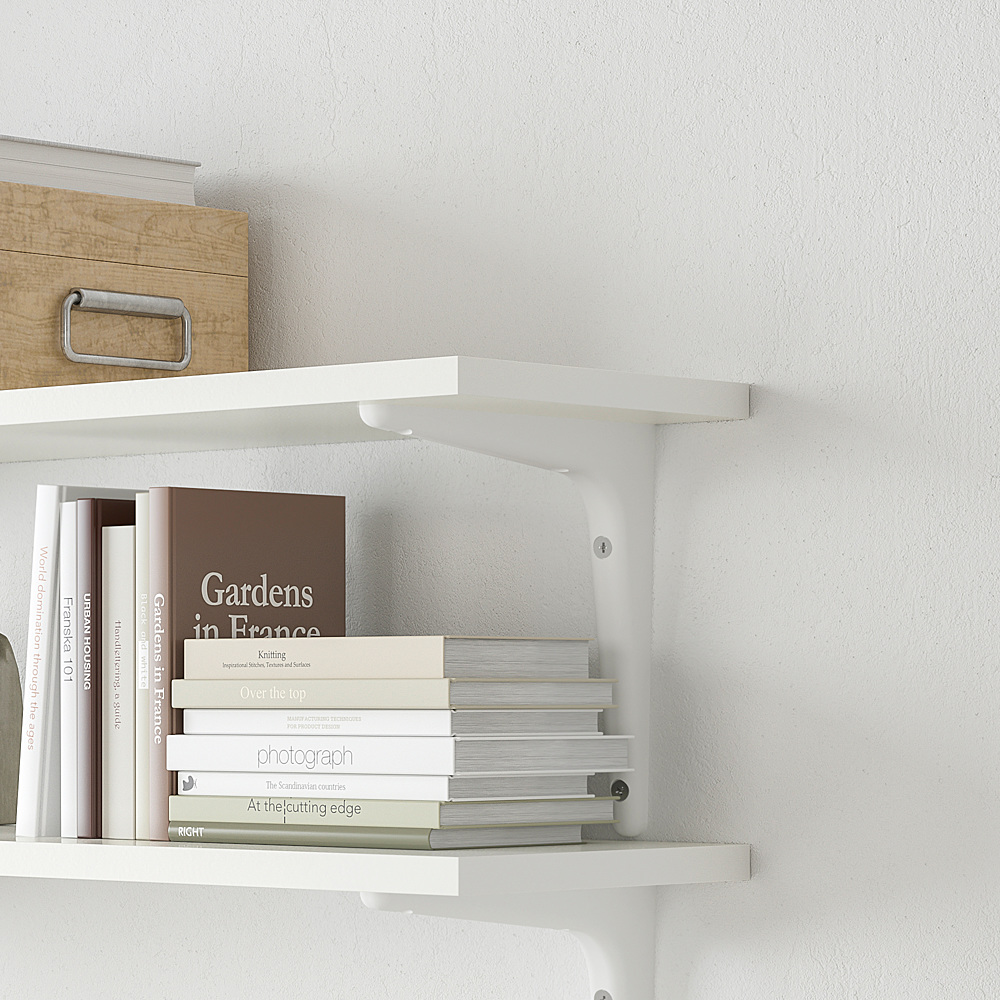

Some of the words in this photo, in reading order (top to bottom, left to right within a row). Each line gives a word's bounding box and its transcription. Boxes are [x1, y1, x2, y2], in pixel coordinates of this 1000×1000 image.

[39, 546, 48, 581] World
[201, 571, 314, 608] Gardens
[34, 584, 46, 650] domination
[83, 593, 91, 634] URBAN
[140, 593, 148, 625] Black
[63, 597, 73, 653] Franska
[153, 593, 165, 662] Gardens
[193, 613, 219, 640] in
[140, 631, 148, 650] and
[83, 636, 91, 690] HOUSING
[258, 650, 287, 661] Knitting
[29, 653, 42, 698] through
[63, 658, 73, 682] 101
[140, 656, 148, 688] white
[154, 666, 165, 682] in
[240, 686, 267, 700] Over
[269, 686, 286, 699] the
[289, 688, 306, 703] top
[30, 702, 39, 720] the
[113, 702, 121, 730] guide
[153, 687, 165, 745] France
[26, 723, 35, 750] ages
[257, 745, 353, 770] photograph
[266, 781, 278, 790] The
[278, 781, 317, 790] Scandinavian
[317, 783, 346, 791] countries
[247, 798, 261, 812] At
[264, 798, 283, 813] the
[286, 800, 327, 817] cutting
[330, 800, 362, 818] edge
[178, 826, 205, 837] RIGHT
